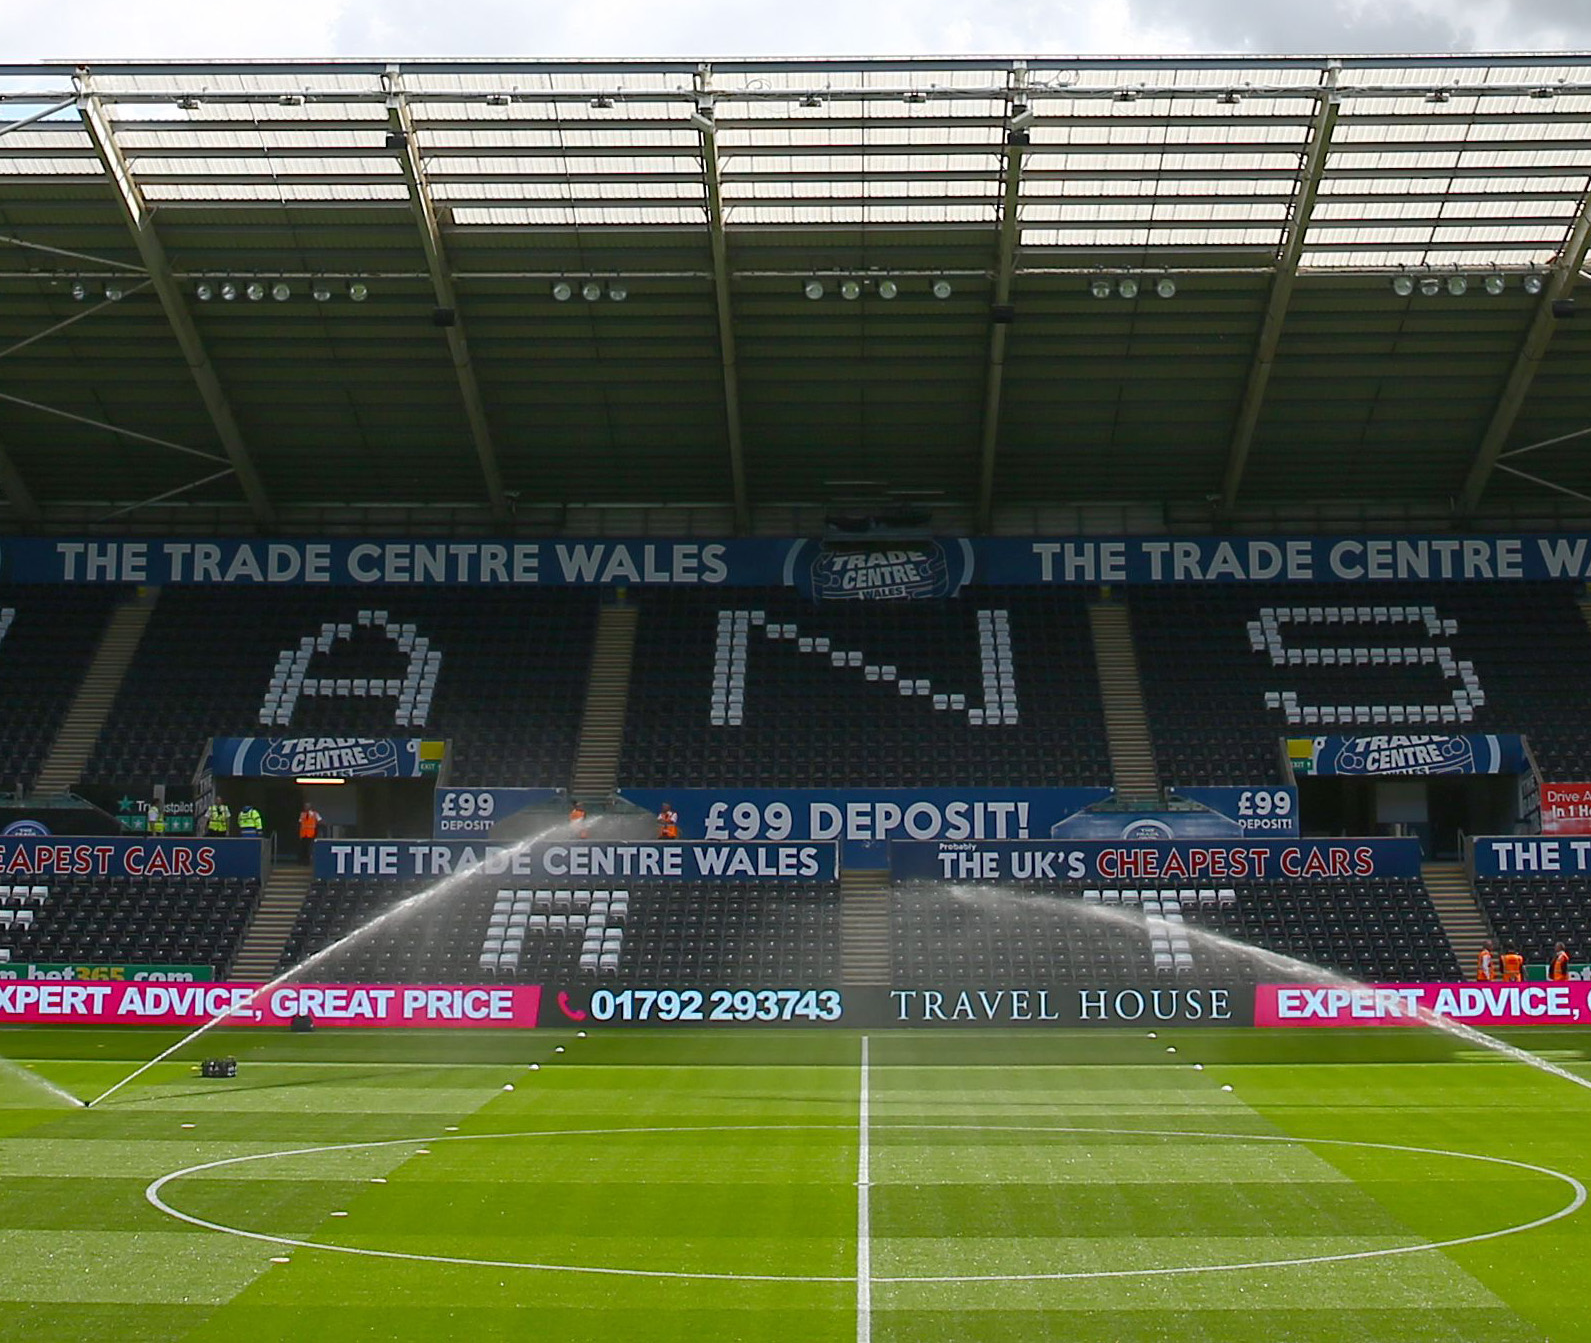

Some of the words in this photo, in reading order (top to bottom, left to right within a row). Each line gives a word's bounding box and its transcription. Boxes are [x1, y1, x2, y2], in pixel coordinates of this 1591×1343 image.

[56, 542, 148, 582] THE
[163, 543, 341, 583] TRADE
[347, 543, 540, 583] CENTRE
[555, 544, 729, 584] WALES
[830, 550, 928, 572] TRADE
[1032, 542, 1127, 582] THE
[1141, 540, 1313, 581] TRADE
[1328, 538, 1524, 580] CENTRE
[841, 564, 921, 591] CENTRE
[858, 585, 907, 600] WALES
[281, 737, 376, 754] TRADE
[1353, 735, 1452, 754] TRADE
[1365, 743, 1445, 772] CENTRE
[290, 746, 369, 773] CENTRE
[420, 763, 436, 771] EXIT
[441, 792, 496, 817] £99
[1237, 790, 1292, 817] £99
[1547, 790, 1580, 802] Drive
[704, 801, 793, 841] £99
[809, 801, 1030, 841] DEPOSIT!
[1238, 818, 1292, 830] DEPOSIT!
[1551, 805, 1567, 818] In
[1568, 806, 1575, 817] 1
[123, 844, 217, 878] CARS
[939, 842, 977, 853] Probably
[1492, 840, 1562, 872] THE
[331, 845, 399, 875] THE
[409, 845, 532, 876] TRADE
[543, 846, 682, 876] CENTRE
[692, 846, 819, 878] WALES
[937, 851, 1001, 879] THE
[1011, 850, 1086, 879] UK'S
[1095, 846, 1271, 879] CHEAPEST
[1280, 846, 1375, 878] CARS
[118, 986, 262, 1022] ADVICE,
[270, 988, 396, 1020] GREAT
[402, 989, 514, 1020] PRICE
[589, 989, 705, 1022] 01792
[709, 989, 843, 1022] 293743
[888, 989, 1060, 1021] TRAVEL
[1079, 989, 1233, 1021] HOUSE
[1277, 989, 1426, 1020] EXPERT
[1432, 986, 1580, 1021] ADVICE,
